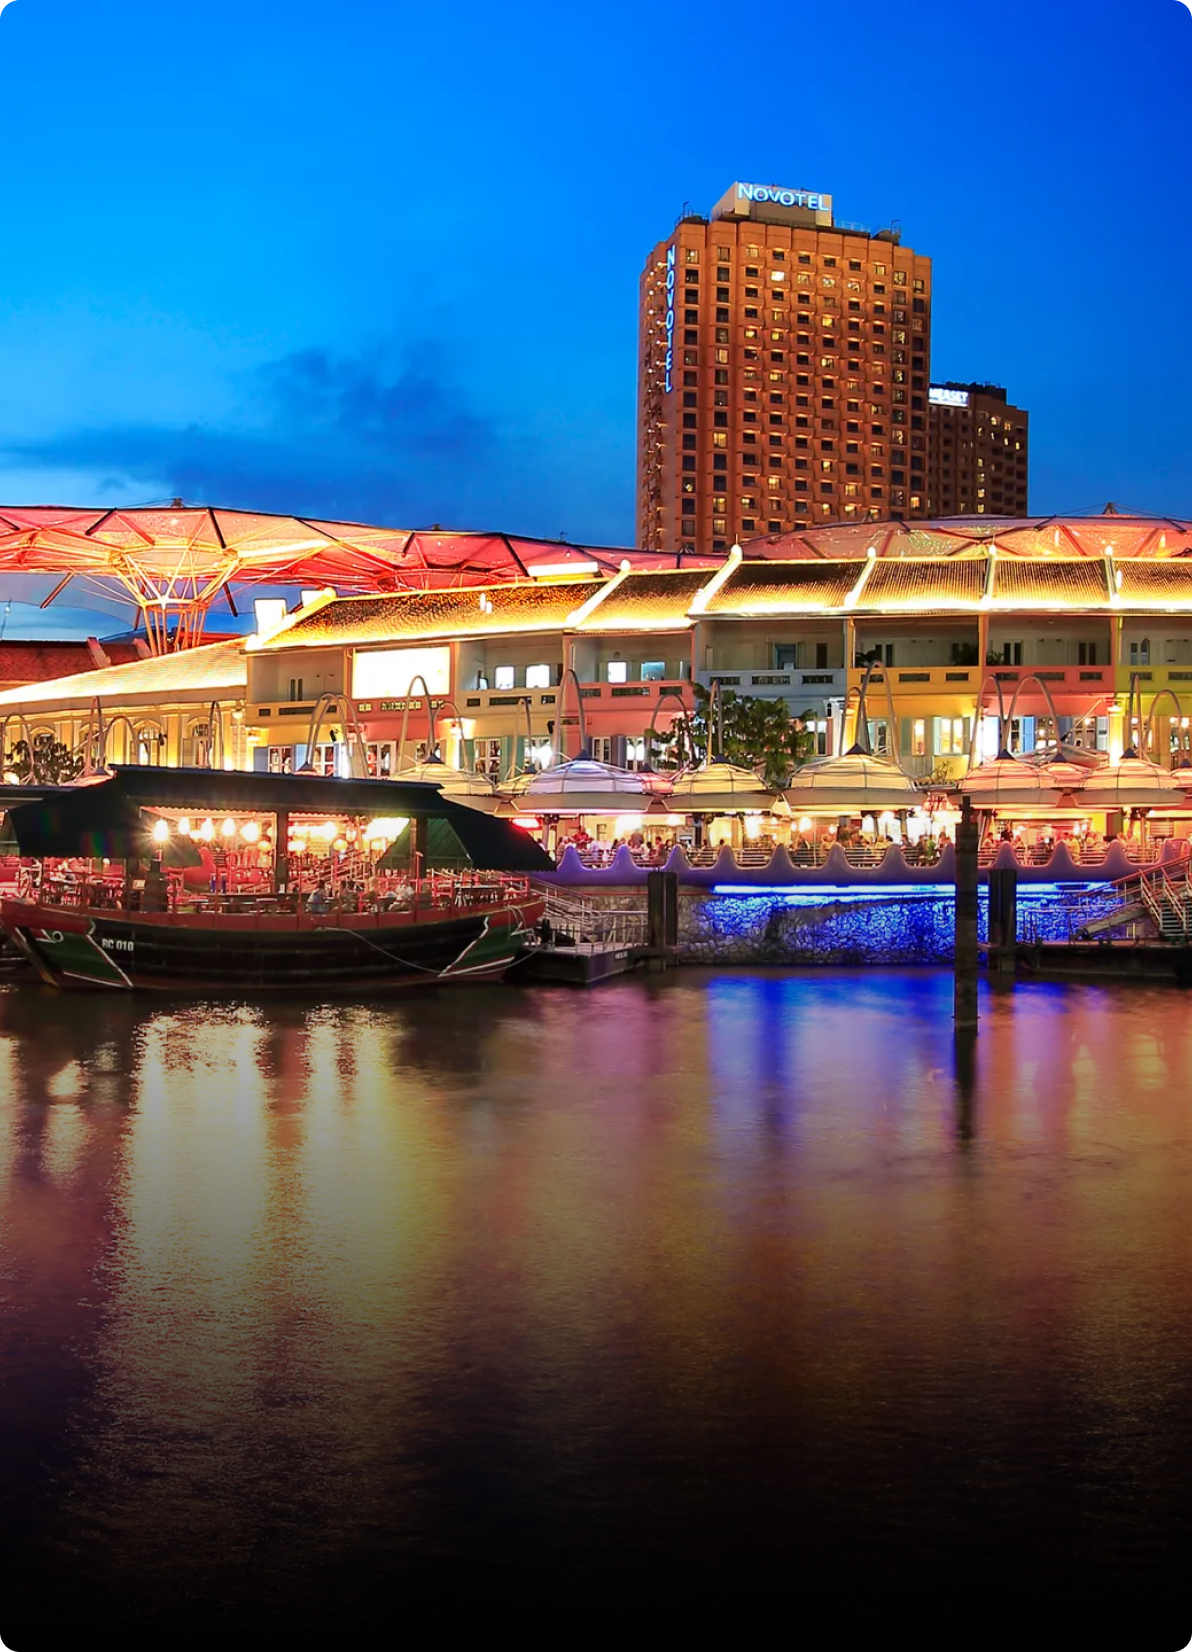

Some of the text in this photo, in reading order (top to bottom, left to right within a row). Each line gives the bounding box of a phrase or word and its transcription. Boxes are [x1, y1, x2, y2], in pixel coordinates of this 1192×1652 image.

[737, 183, 830, 211] NOVOTEL
[665, 244, 676, 393] NOVOTEL
[115, 940, 134, 951] 010
